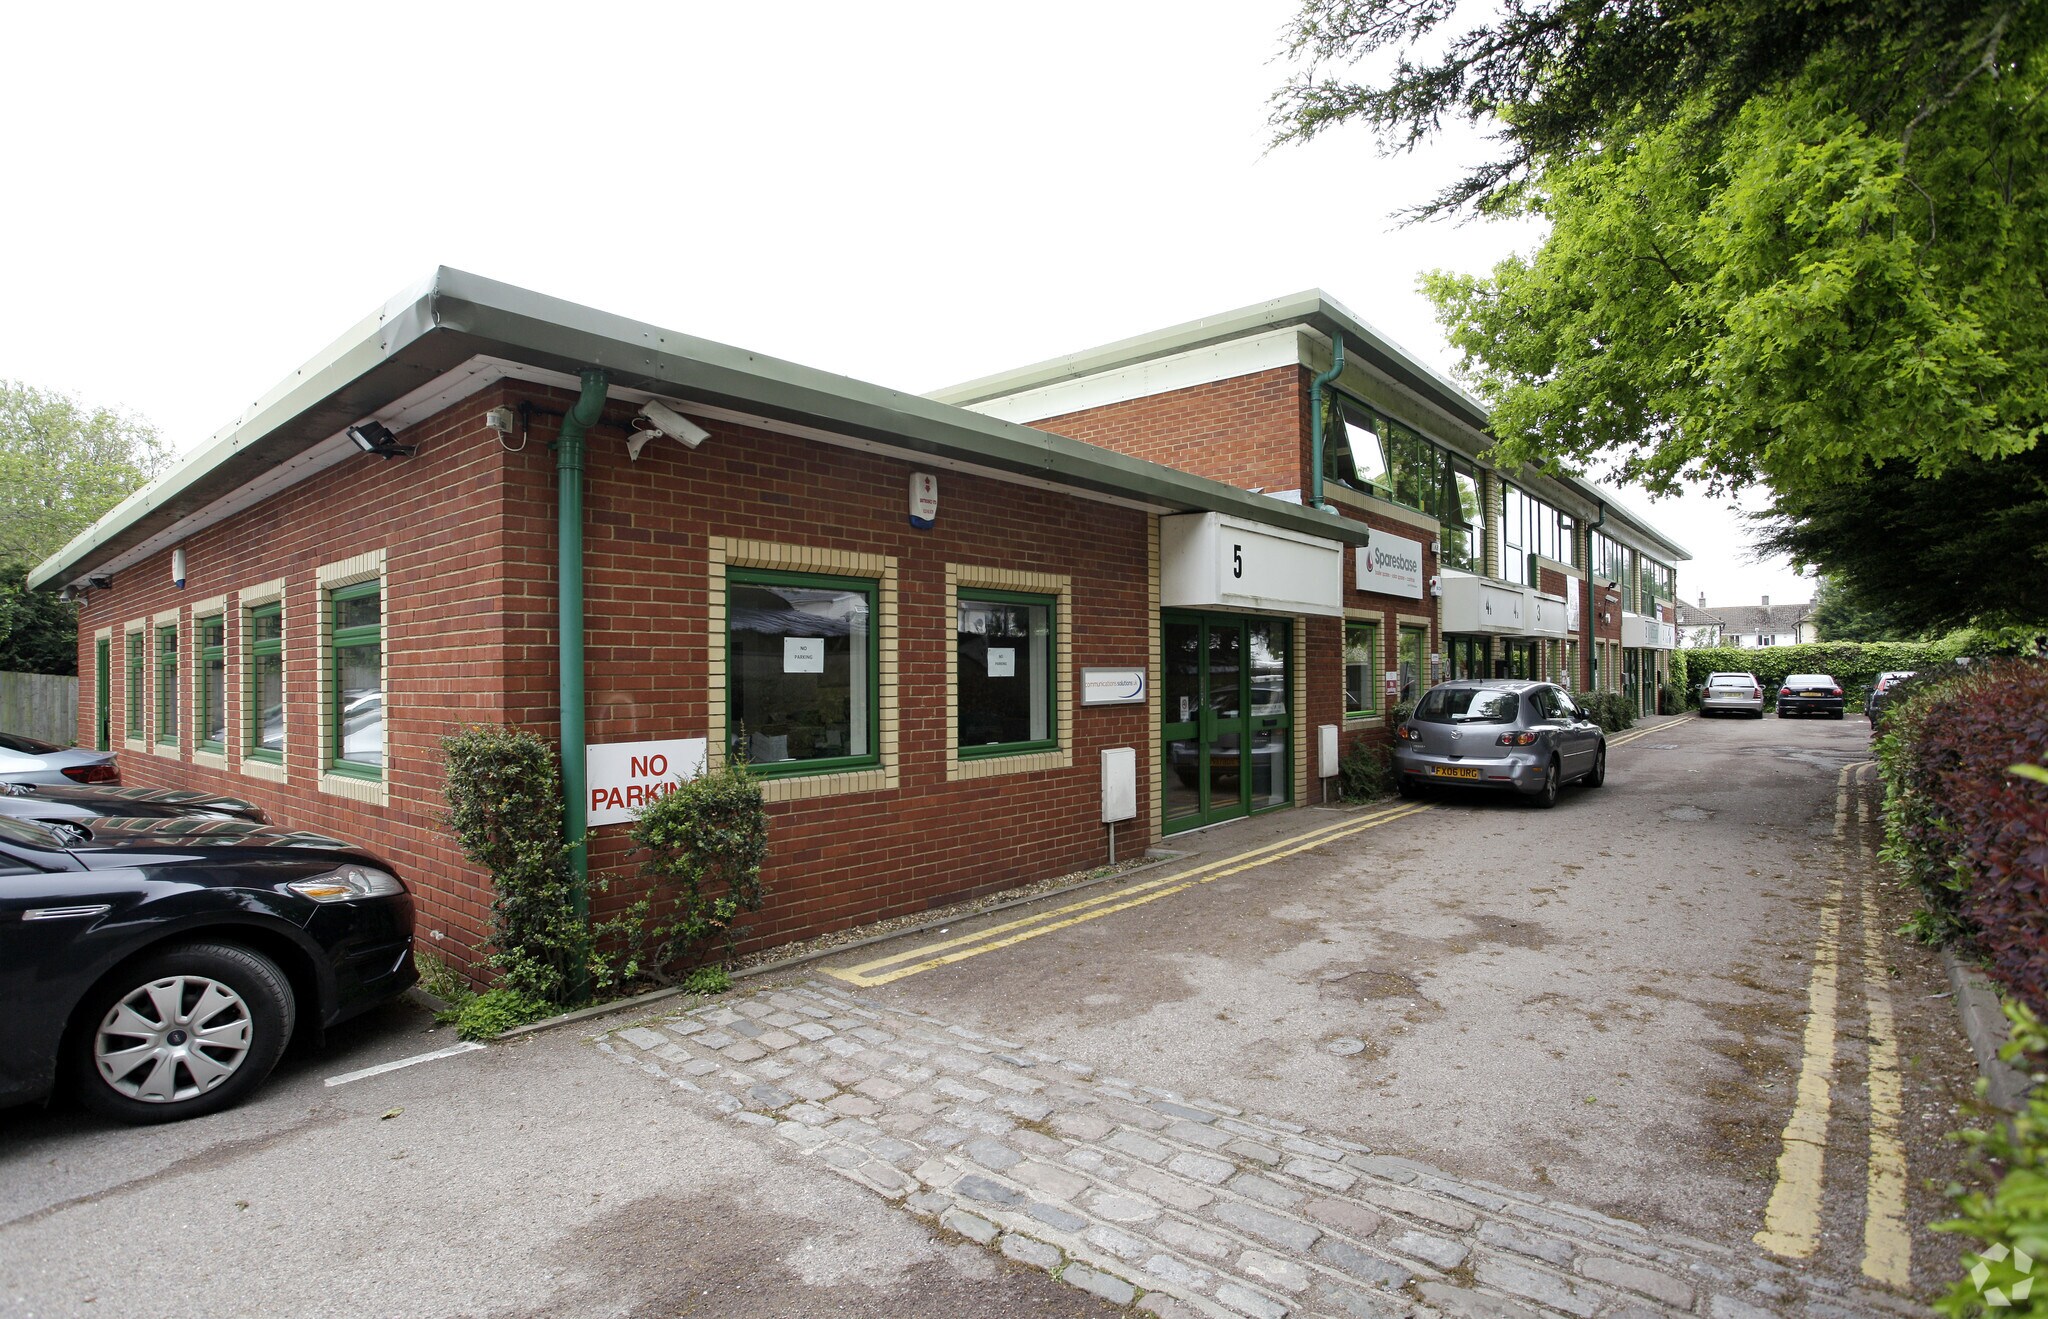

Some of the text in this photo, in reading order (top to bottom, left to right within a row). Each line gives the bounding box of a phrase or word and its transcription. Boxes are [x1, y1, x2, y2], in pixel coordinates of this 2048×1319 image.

[1233, 544, 1243, 579] 5
[1374, 547, 1418, 573] Sparesbase
[1536, 604, 1541, 621] 3
[630, 754, 669, 778] NO
[1435, 767, 1478, 778] FX06 URG
[591, 780, 700, 812] PARKI
